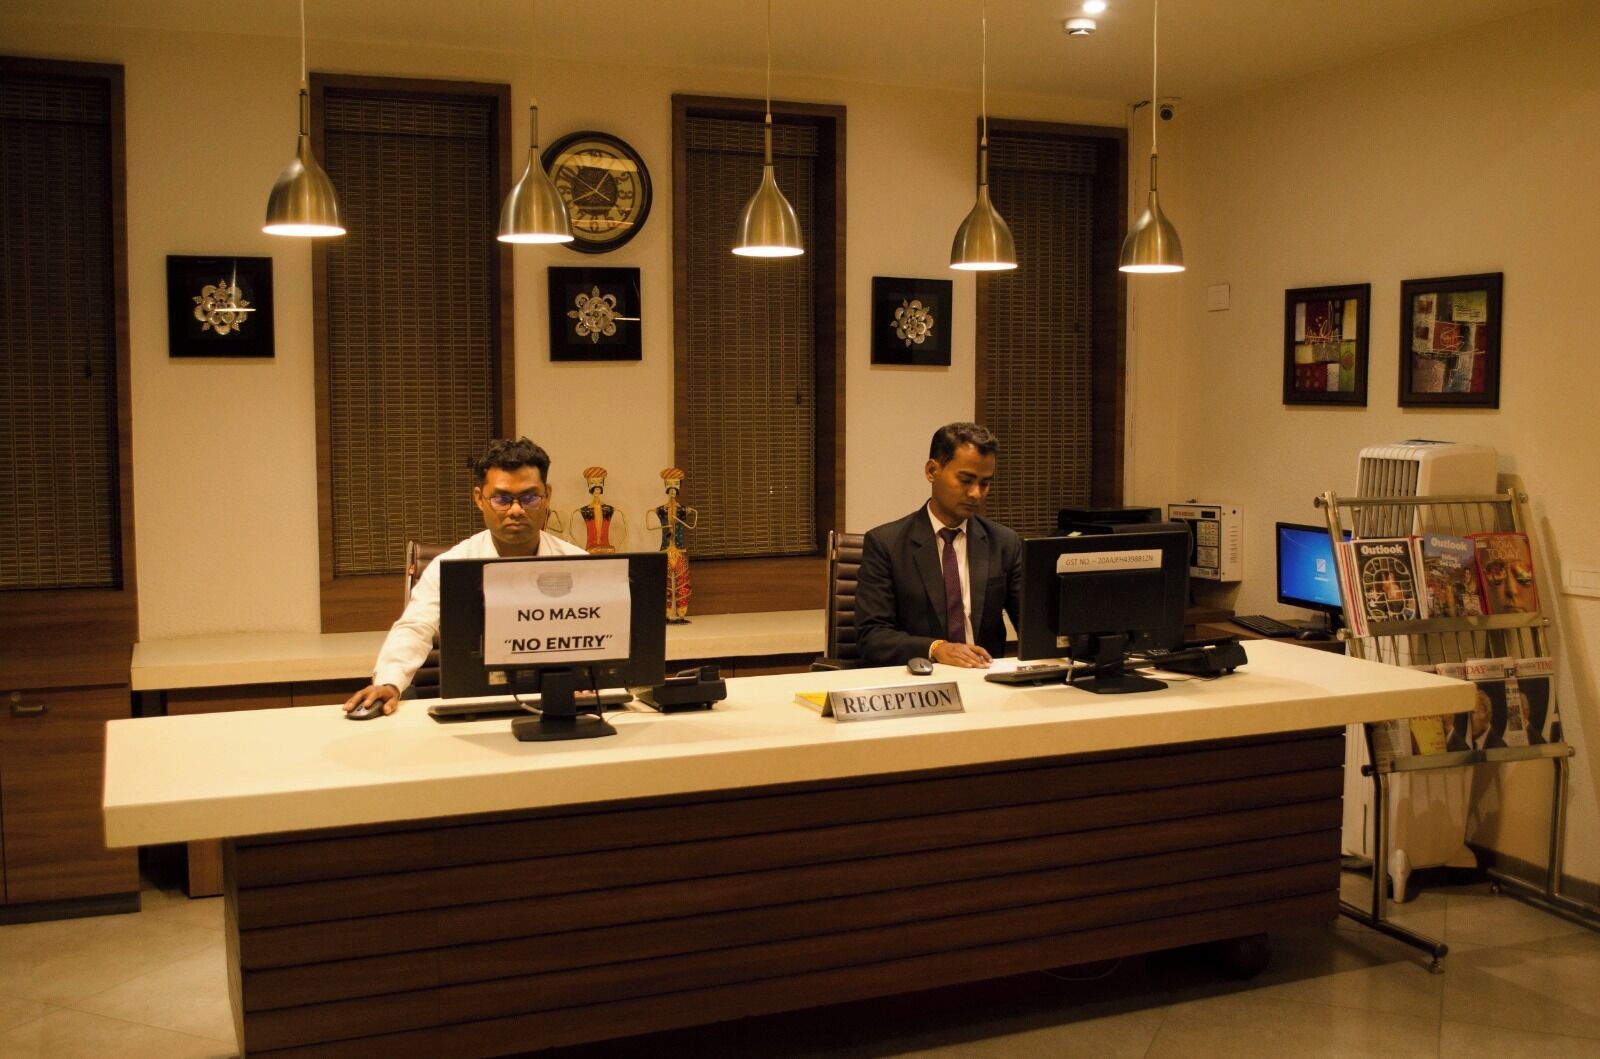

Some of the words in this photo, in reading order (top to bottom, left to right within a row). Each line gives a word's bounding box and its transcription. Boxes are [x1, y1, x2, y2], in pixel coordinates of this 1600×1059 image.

[1360, 545, 1403, 555] Outlook
[1430, 537, 1468, 551] Outlook
[517, 609, 544, 622] NO
[550, 606, 600, 620] MASK
[843, 689, 952, 714] RECEPTION
